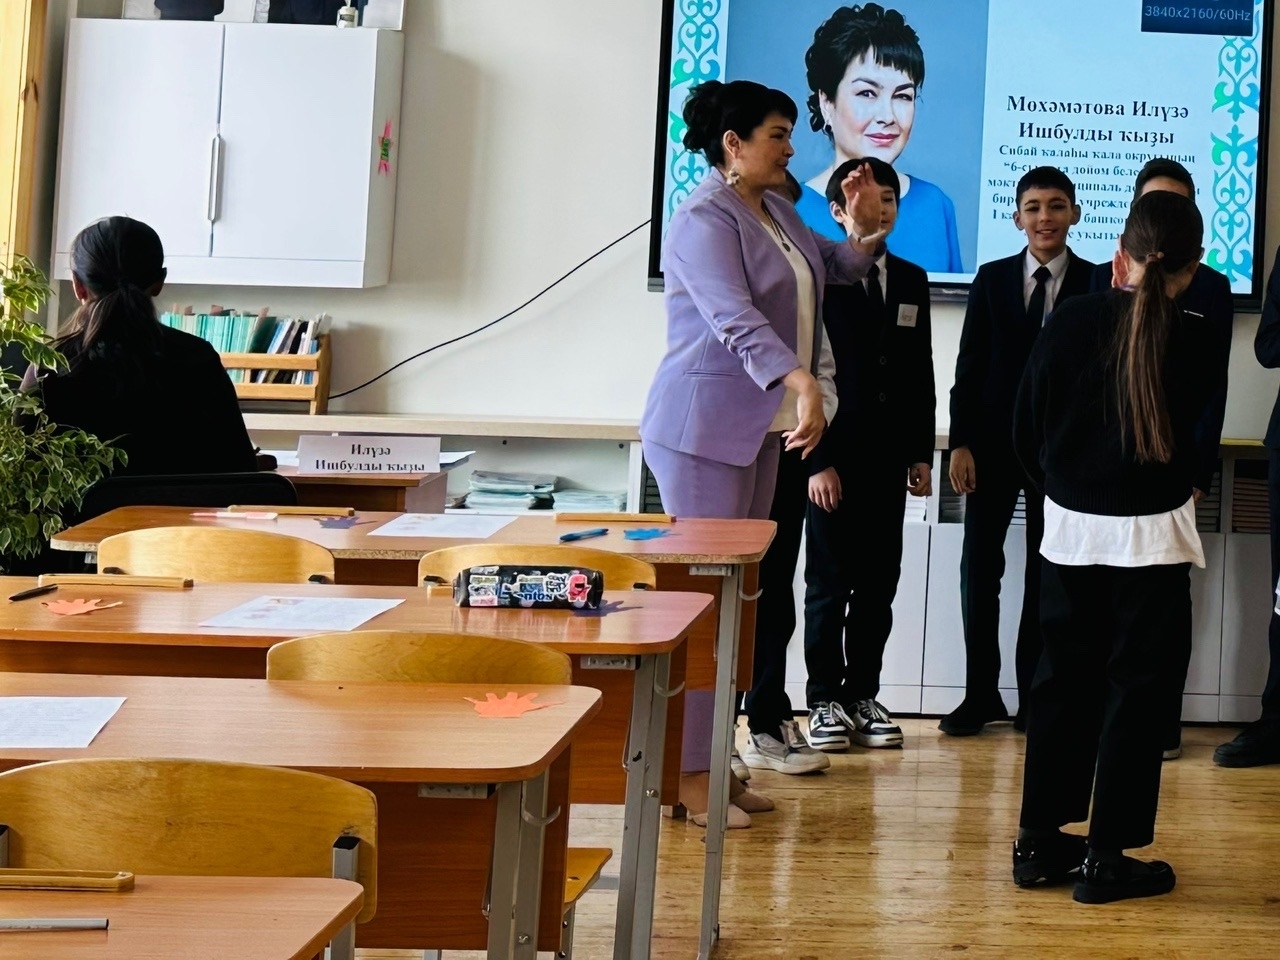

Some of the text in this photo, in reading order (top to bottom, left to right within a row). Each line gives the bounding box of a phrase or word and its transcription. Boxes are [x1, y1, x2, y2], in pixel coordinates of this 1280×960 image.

[1144, 6, 1251, 21] 3840x2160/60Hz
[1133, 101, 1189, 122] Илүзә
[1019, 122, 1113, 144] Ишбулды
[999, 144, 1038, 157] Сибай
[315, 459, 382, 473] Ишбулды
